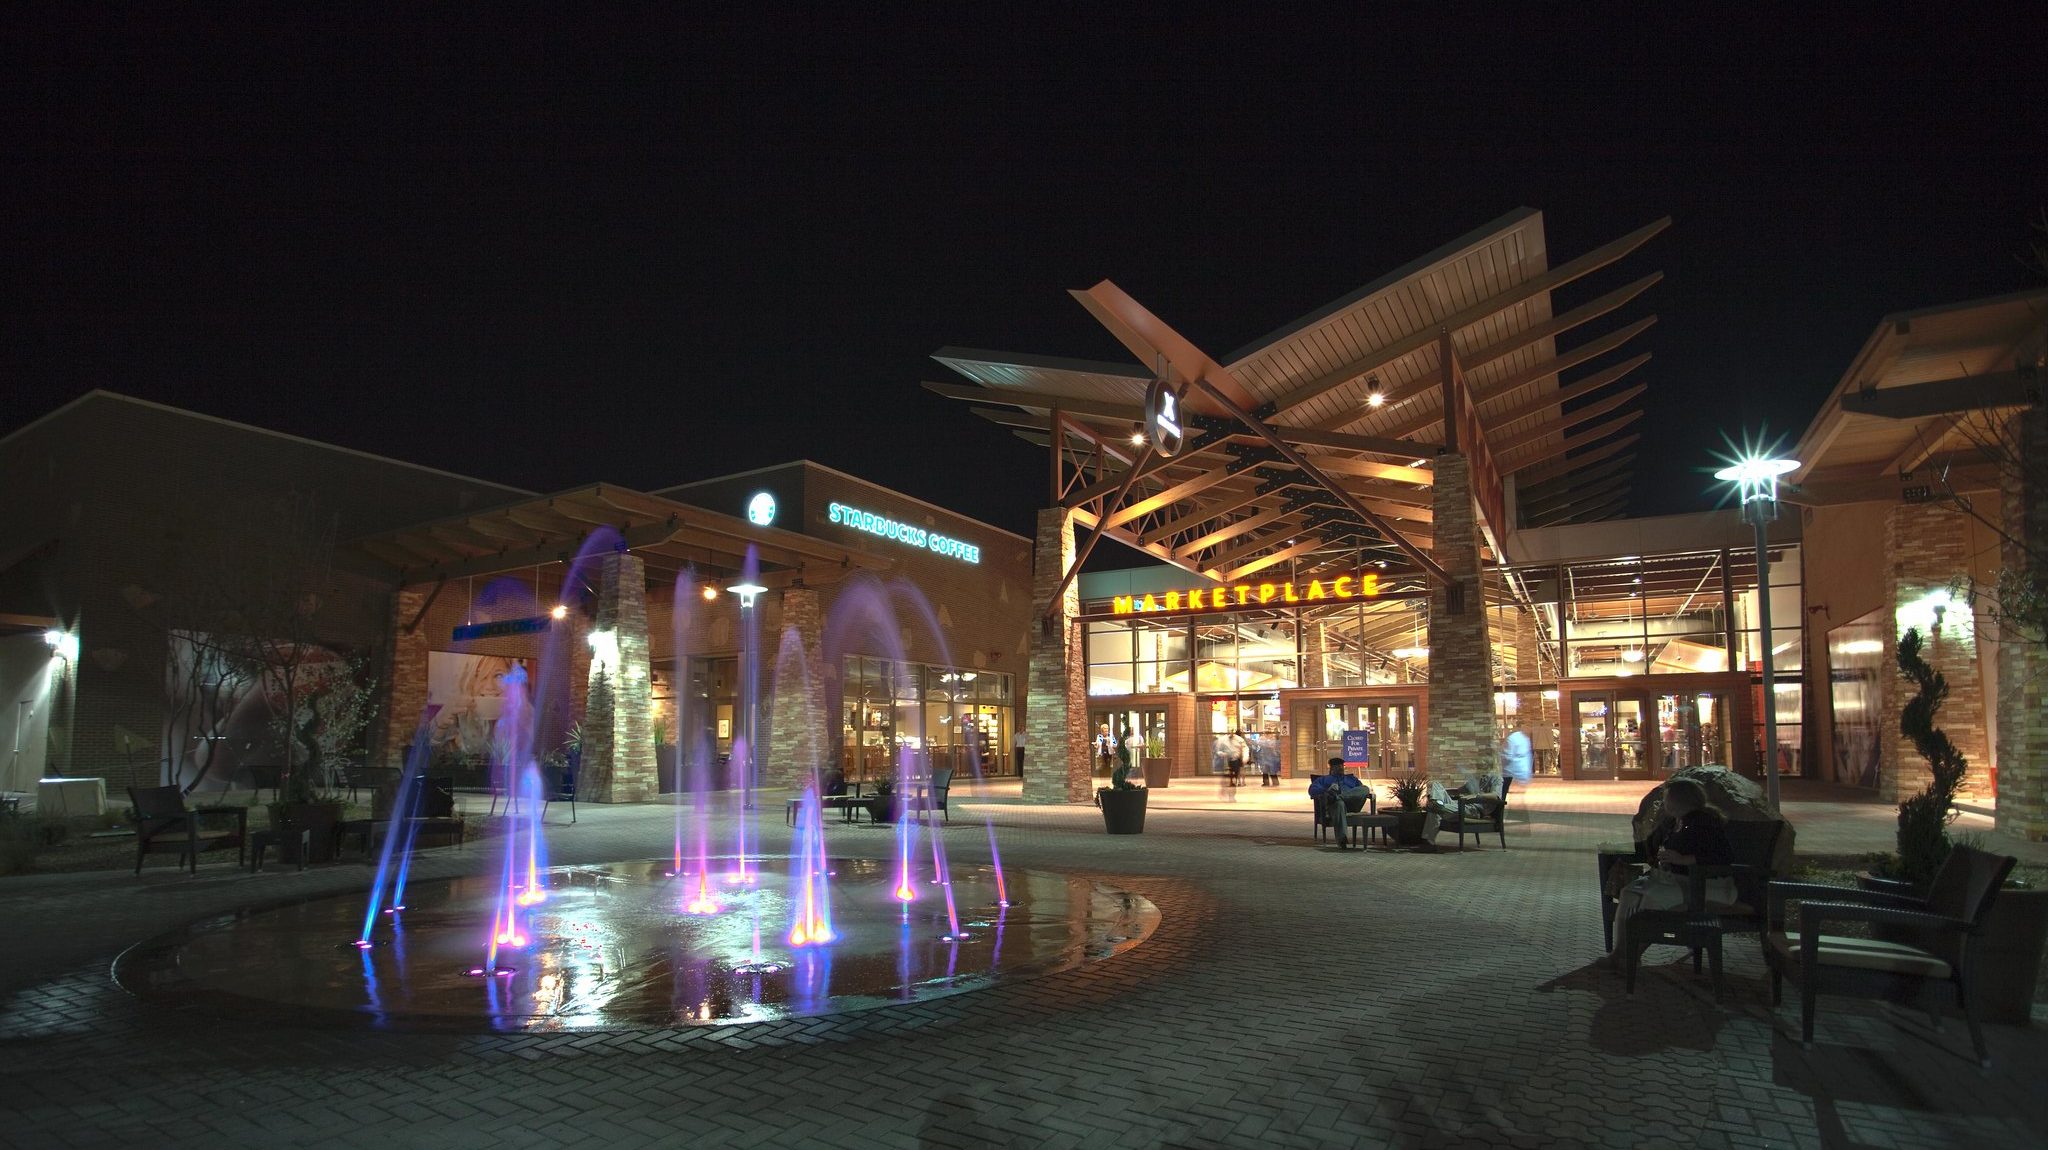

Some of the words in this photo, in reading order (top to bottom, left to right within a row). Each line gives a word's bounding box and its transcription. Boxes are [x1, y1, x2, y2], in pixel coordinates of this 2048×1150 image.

[829, 502, 927, 548] STARBUCKS
[928, 533, 980, 564] COFFEE
[1112, 574, 1380, 615] MARKETPLACE
